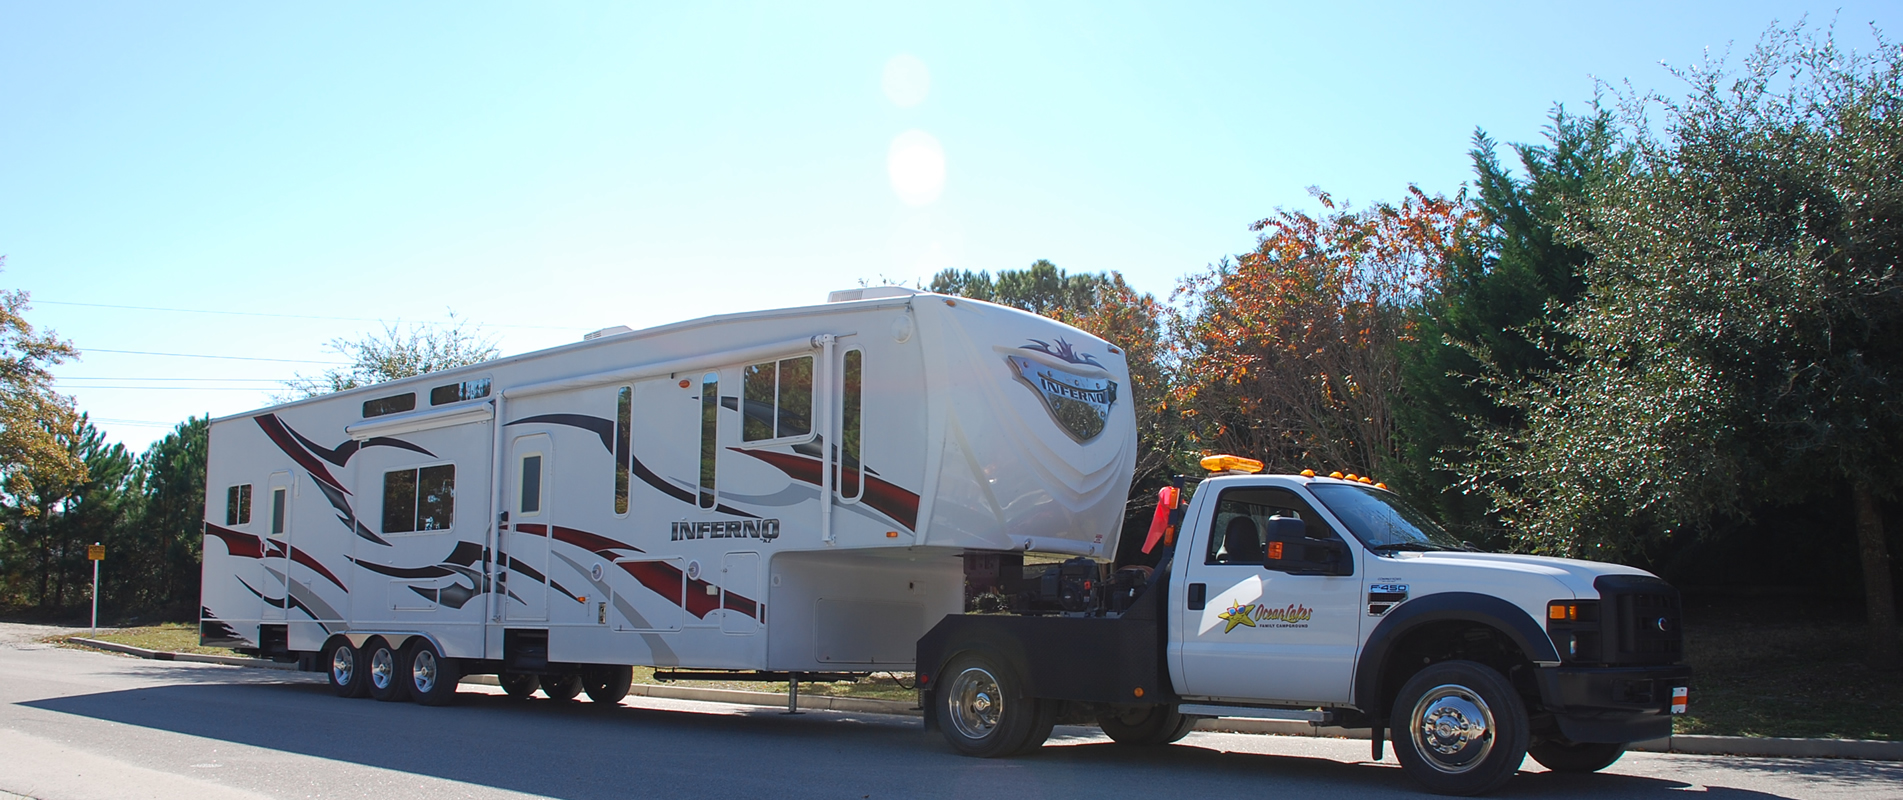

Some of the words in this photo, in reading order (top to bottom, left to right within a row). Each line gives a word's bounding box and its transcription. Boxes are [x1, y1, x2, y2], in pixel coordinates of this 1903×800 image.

[1040, 378, 1105, 403] INFERNO
[671, 519, 780, 541] INFERNO
[1255, 603, 1285, 621] Ocean
[1281, 603, 1313, 623] Lakes
